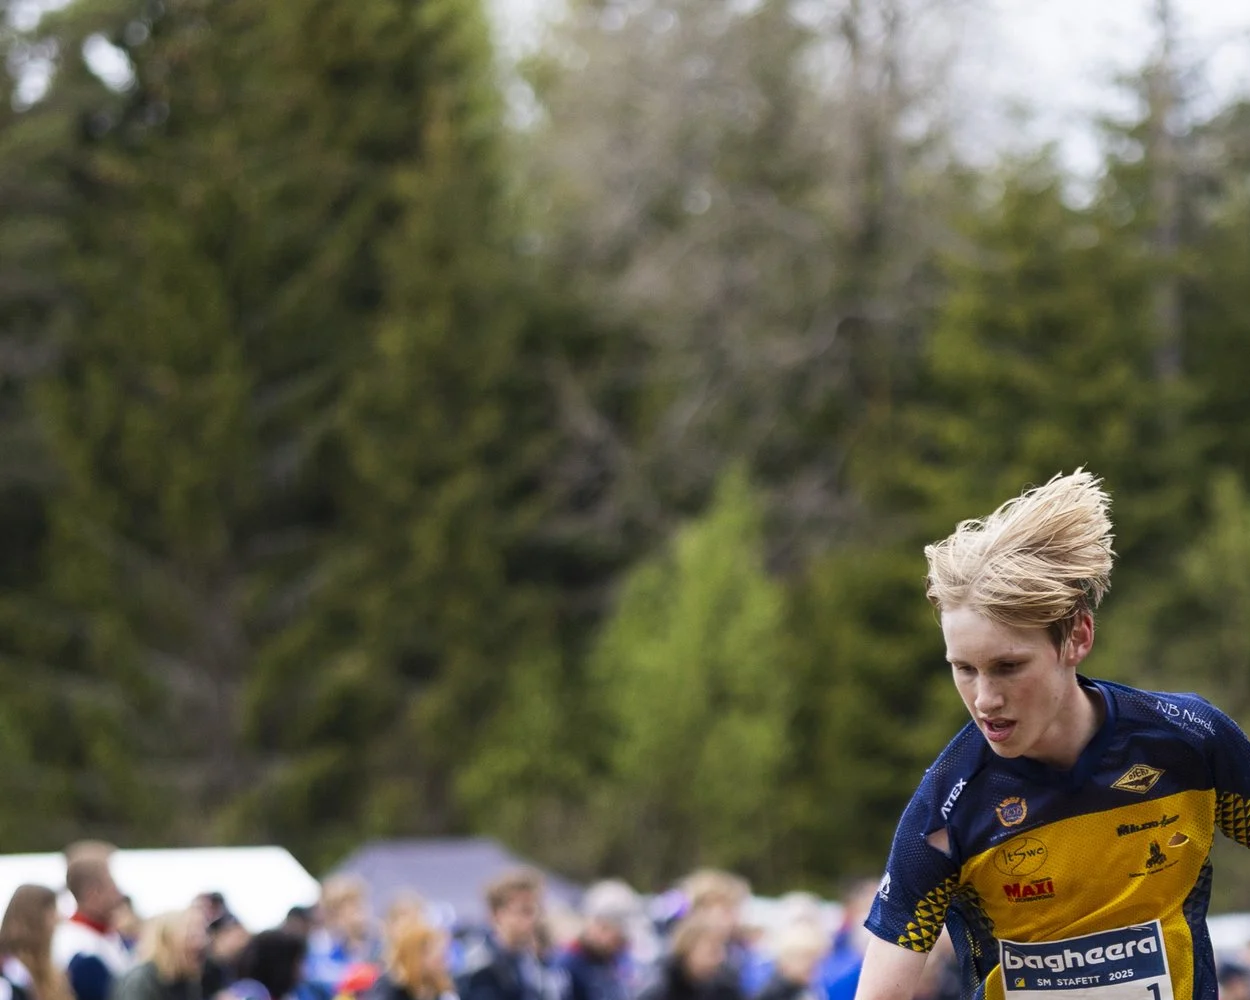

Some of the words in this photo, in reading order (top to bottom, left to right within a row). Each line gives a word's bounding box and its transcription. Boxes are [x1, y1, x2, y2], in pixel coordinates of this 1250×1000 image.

[1156, 701, 1180, 717] NB
[1183, 709, 1217, 736] Nordic
[1005, 935, 1158, 972] bagheera
[1037, 978, 1052, 987] SM
[1057, 975, 1101, 986] STAFETT
[1109, 968, 1134, 981] 2025
